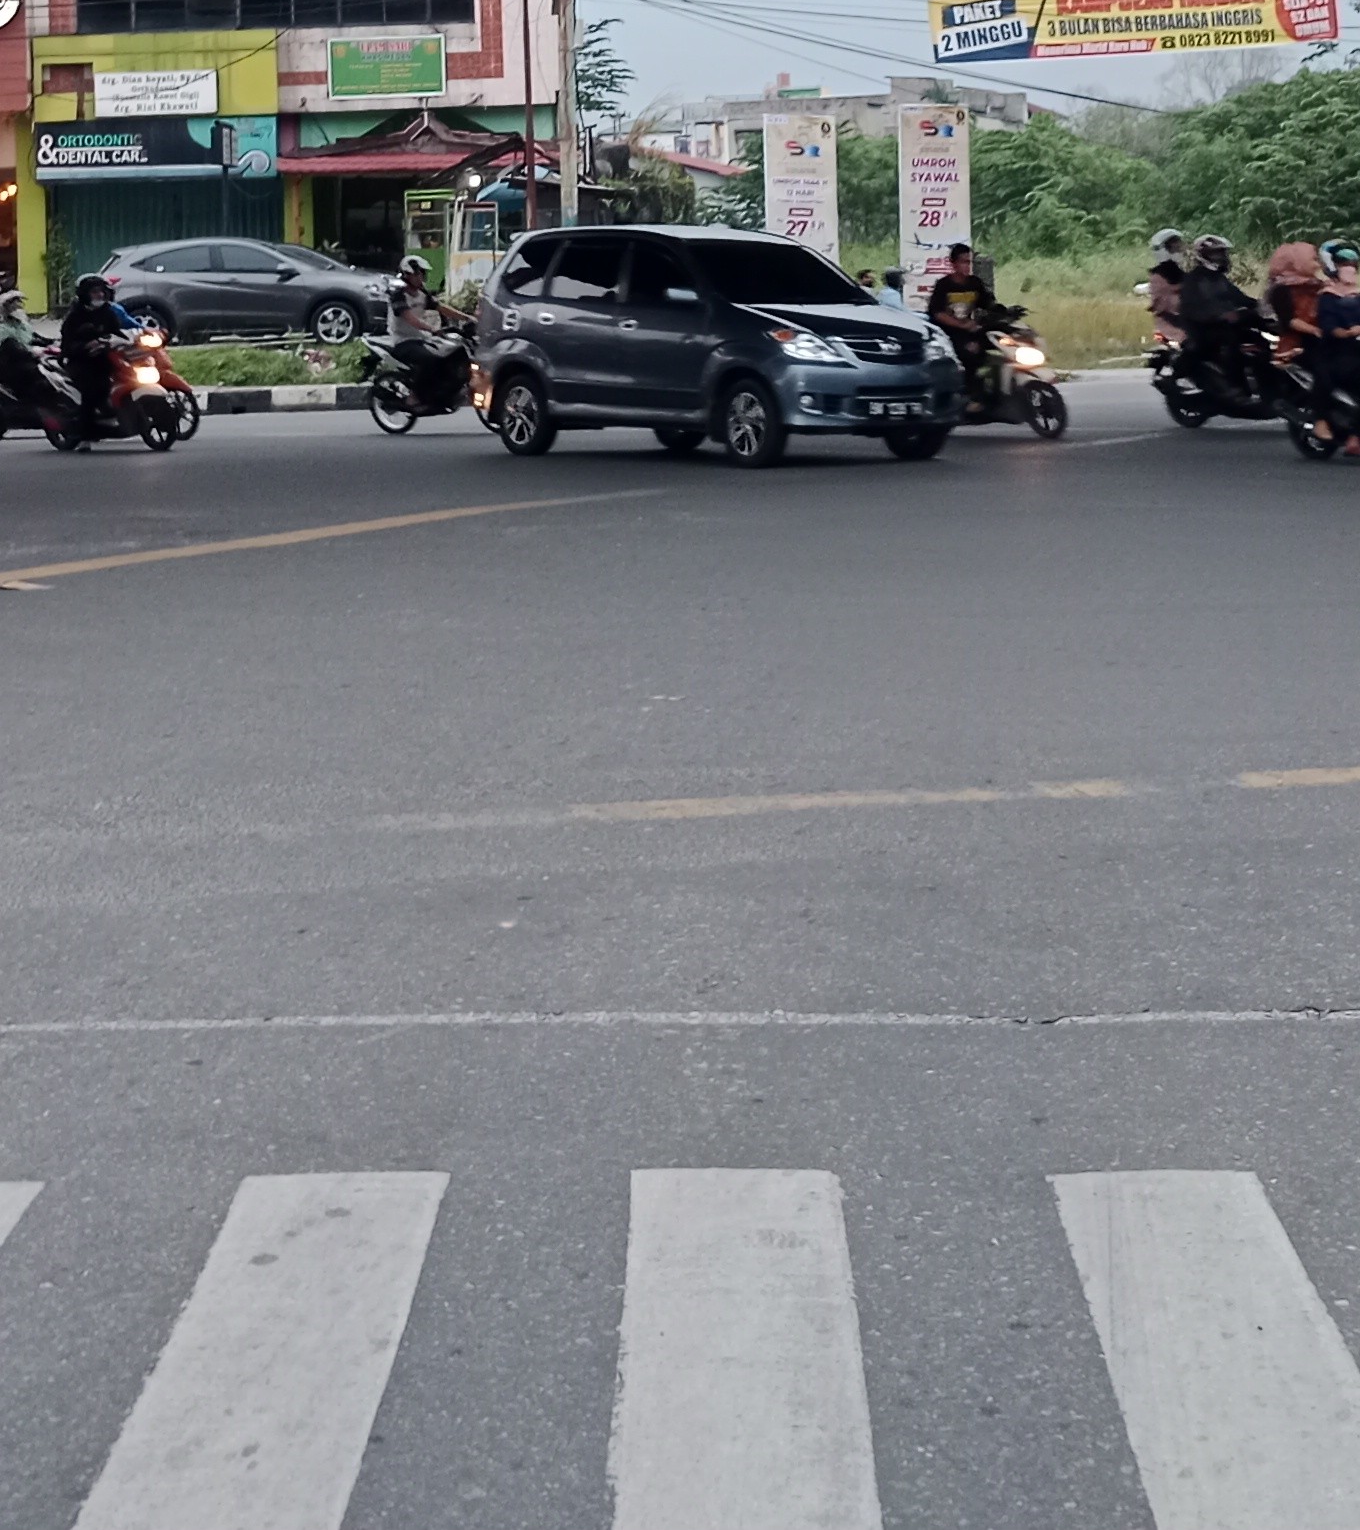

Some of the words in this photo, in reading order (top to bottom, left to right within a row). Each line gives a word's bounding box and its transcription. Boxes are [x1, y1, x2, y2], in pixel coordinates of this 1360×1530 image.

[952, 0, 1002, 25] PAKET
[1047, 20, 1056, 37] 3
[1059, 18, 1100, 36] BULAN
[1102, 16, 1134, 33] BISA
[1135, 11, 1208, 31] BERBAHASA
[1211, 7, 1263, 26] INGGRIS
[942, 34, 953, 52] 2
[955, 20, 1023, 49] MINGGU
[1180, 32, 1211, 47] 0823
[1213, 30, 1242, 46] 8221
[1245, 28, 1275, 45] 8991
[37, 133, 59, 165] &
[59, 150, 110, 165] DENTAL
[911, 157, 957, 168] UMROH
[910, 171, 961, 183] SYAWAL
[918, 210, 941, 228] 28
[785, 220, 809, 237] 27
